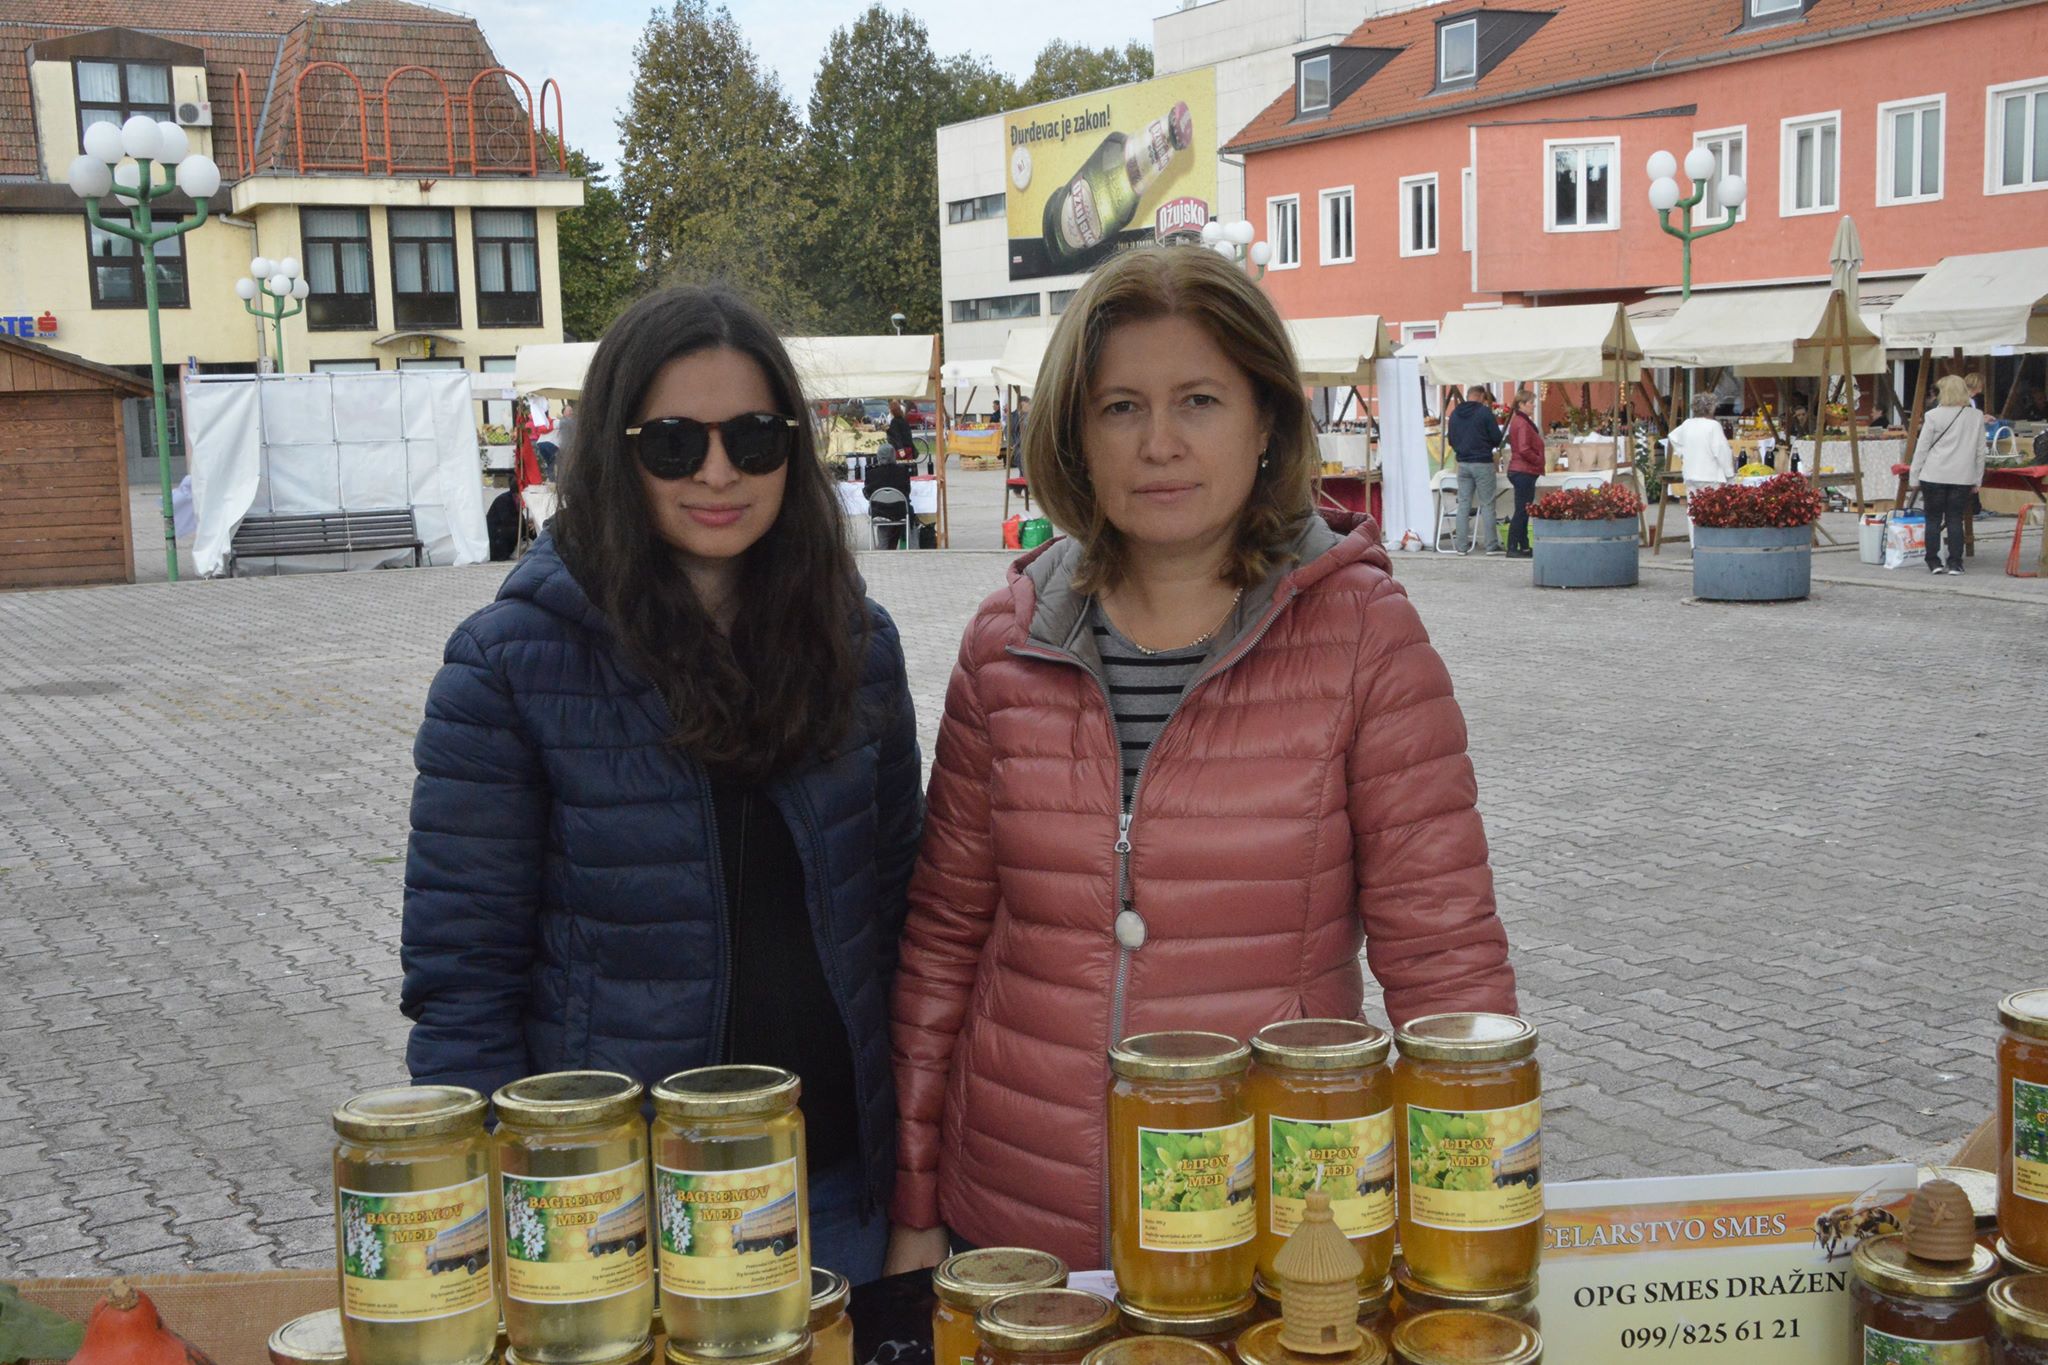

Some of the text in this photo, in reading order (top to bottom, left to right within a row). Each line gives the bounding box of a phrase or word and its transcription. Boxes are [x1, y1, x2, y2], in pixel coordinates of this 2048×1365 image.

[1010, 104, 1110, 146] Đurđevac je zakon!
[1160, 199, 1205, 234] Ožujsko
[1442, 1138, 1494, 1150] LIPOV
[1311, 1147, 1359, 1160] LIPOV
[1450, 1155, 1489, 1167] MED
[1182, 1155, 1229, 1170] LIPOV
[1188, 1175, 1224, 1187] MED
[528, 1187, 624, 1209] BAGREMOV
[677, 1185, 770, 1203] BAGREMOV
[366, 1203, 464, 1225] BAGREMOV
[556, 1211, 599, 1226] MED
[703, 1208, 742, 1221] MED
[1712, 1213, 1787, 1239] SMES
[394, 1228, 438, 1243] MED
[1574, 1268, 1847, 1308] OPG SMES DRAŽEN
[1621, 1317, 1801, 1350] 099/825 61 21
